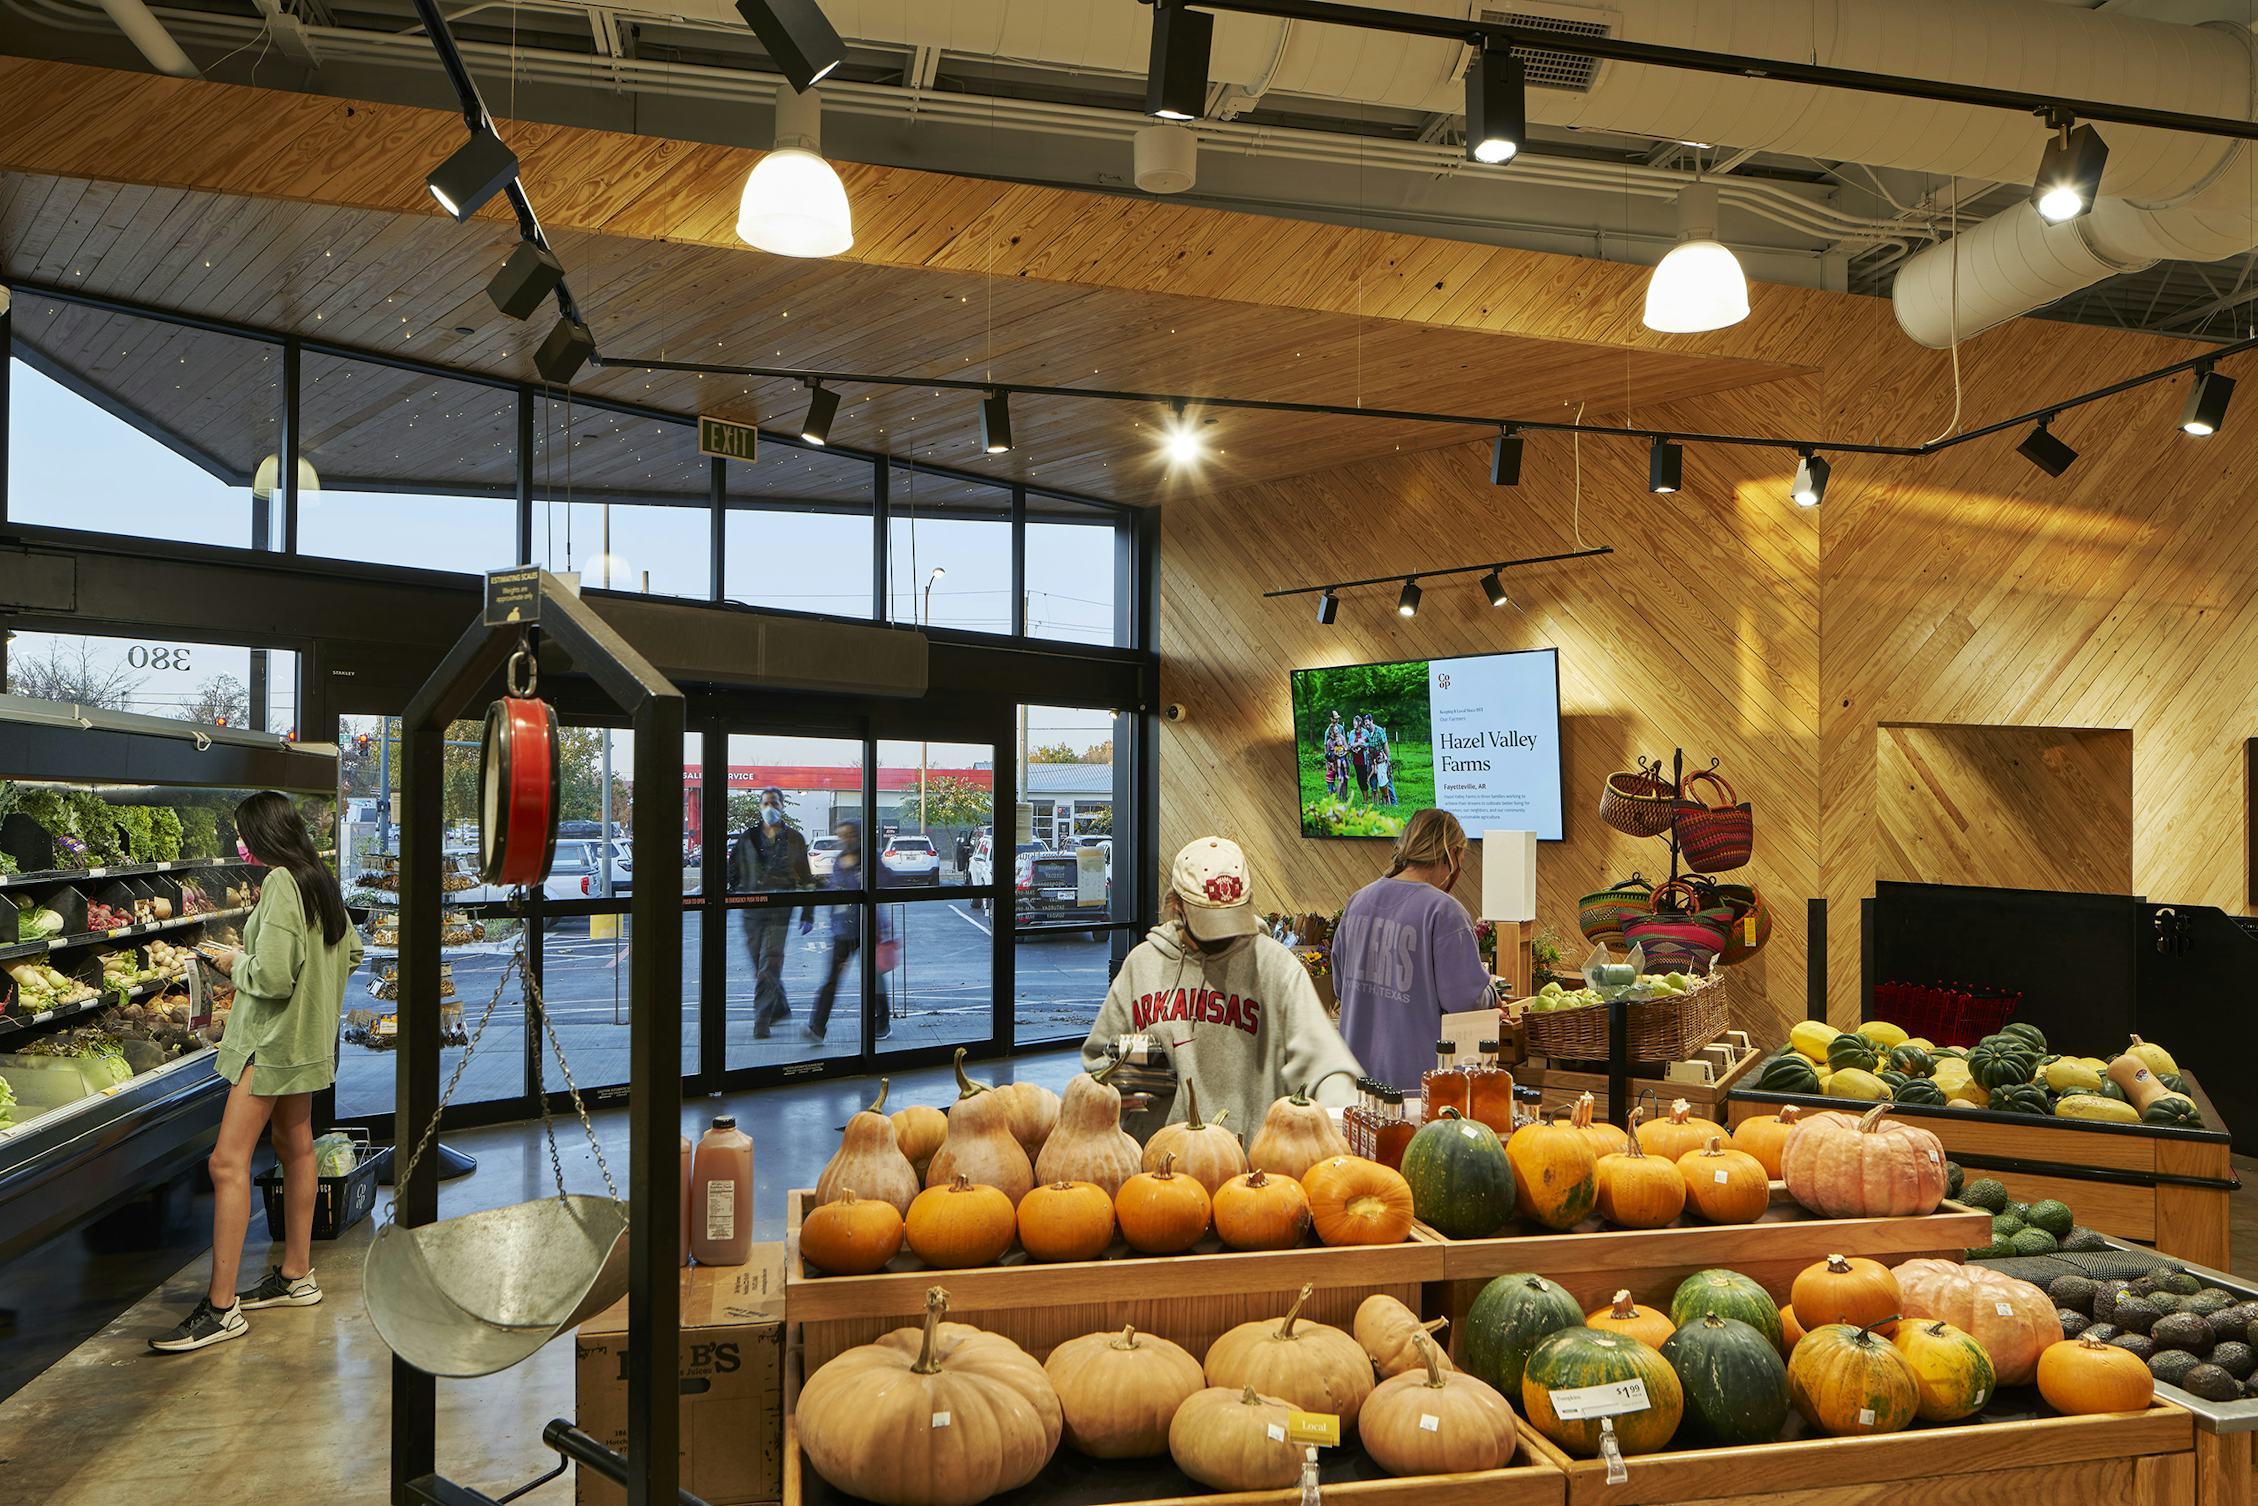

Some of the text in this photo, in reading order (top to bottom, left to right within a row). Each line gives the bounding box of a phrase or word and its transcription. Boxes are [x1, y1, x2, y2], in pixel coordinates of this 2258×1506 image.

[711, 423, 749, 457] EXIT
[521, 571, 538, 581] SCALES
[1440, 730, 1537, 751] Hazel Valley
[1441, 756, 1491, 772] Farms
[1443, 783, 1477, 791] Fayetteville,
[1378, 986, 1411, 1003] TEXAS
[1132, 988, 1260, 1035] ARKANSAS
[1302, 1420, 1327, 1432] Local
